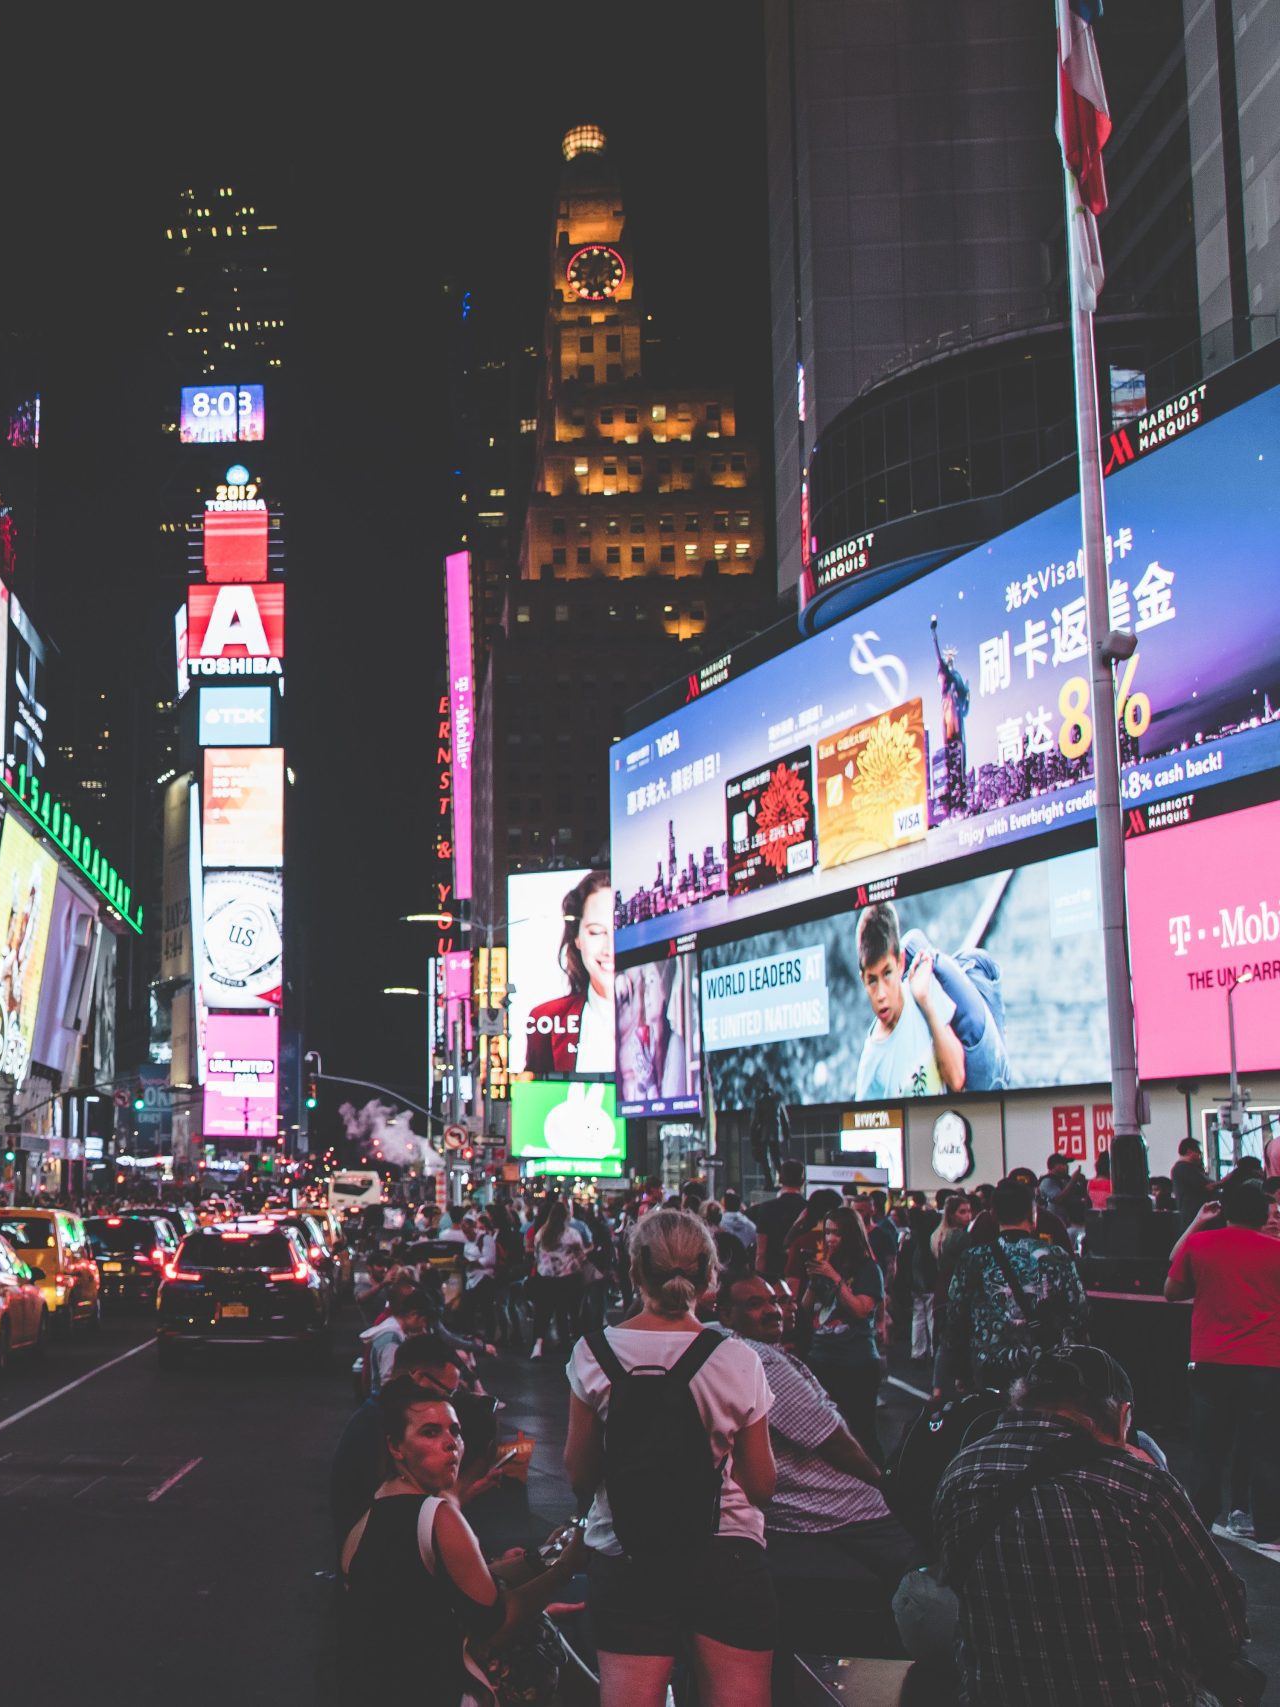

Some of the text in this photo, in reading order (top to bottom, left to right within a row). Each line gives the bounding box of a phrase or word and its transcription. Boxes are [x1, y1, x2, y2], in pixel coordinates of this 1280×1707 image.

[192, 391, 253, 419] 8:03
[1138, 384, 1207, 434] MARRIOTT
[1138, 407, 1201, 451] MARQUIS
[205, 499, 267, 512] TOSHIBA
[216, 485, 258, 502] 2017
[818, 532, 875, 572] MARRIOTT
[818, 553, 868, 589] MARQUIS
[200, 584, 271, 656] A
[188, 658, 283, 676] TOSHIBA
[701, 654, 732, 680] MARRIOTT
[701, 668, 729, 692] MARQUIS
[220, 708, 267, 726] TDK
[958, 828, 985, 847] Enjoy
[986, 819, 1009, 838] with
[1009, 801, 1065, 832] Everbright
[1155, 762, 1184, 789] cash
[1186, 750, 1223, 779] back!
[1148, 794, 1195, 815] MARRIOTT
[897, 812, 921, 832] VISA
[1148, 809, 1191, 829] MARQUIS
[706, 971, 746, 1000] WORLD
[749, 958, 802, 992] LEADERS
[1187, 969, 1215, 991] THE
[526, 1015, 580, 1035] COLE
[721, 1008, 762, 1038] UNITED
